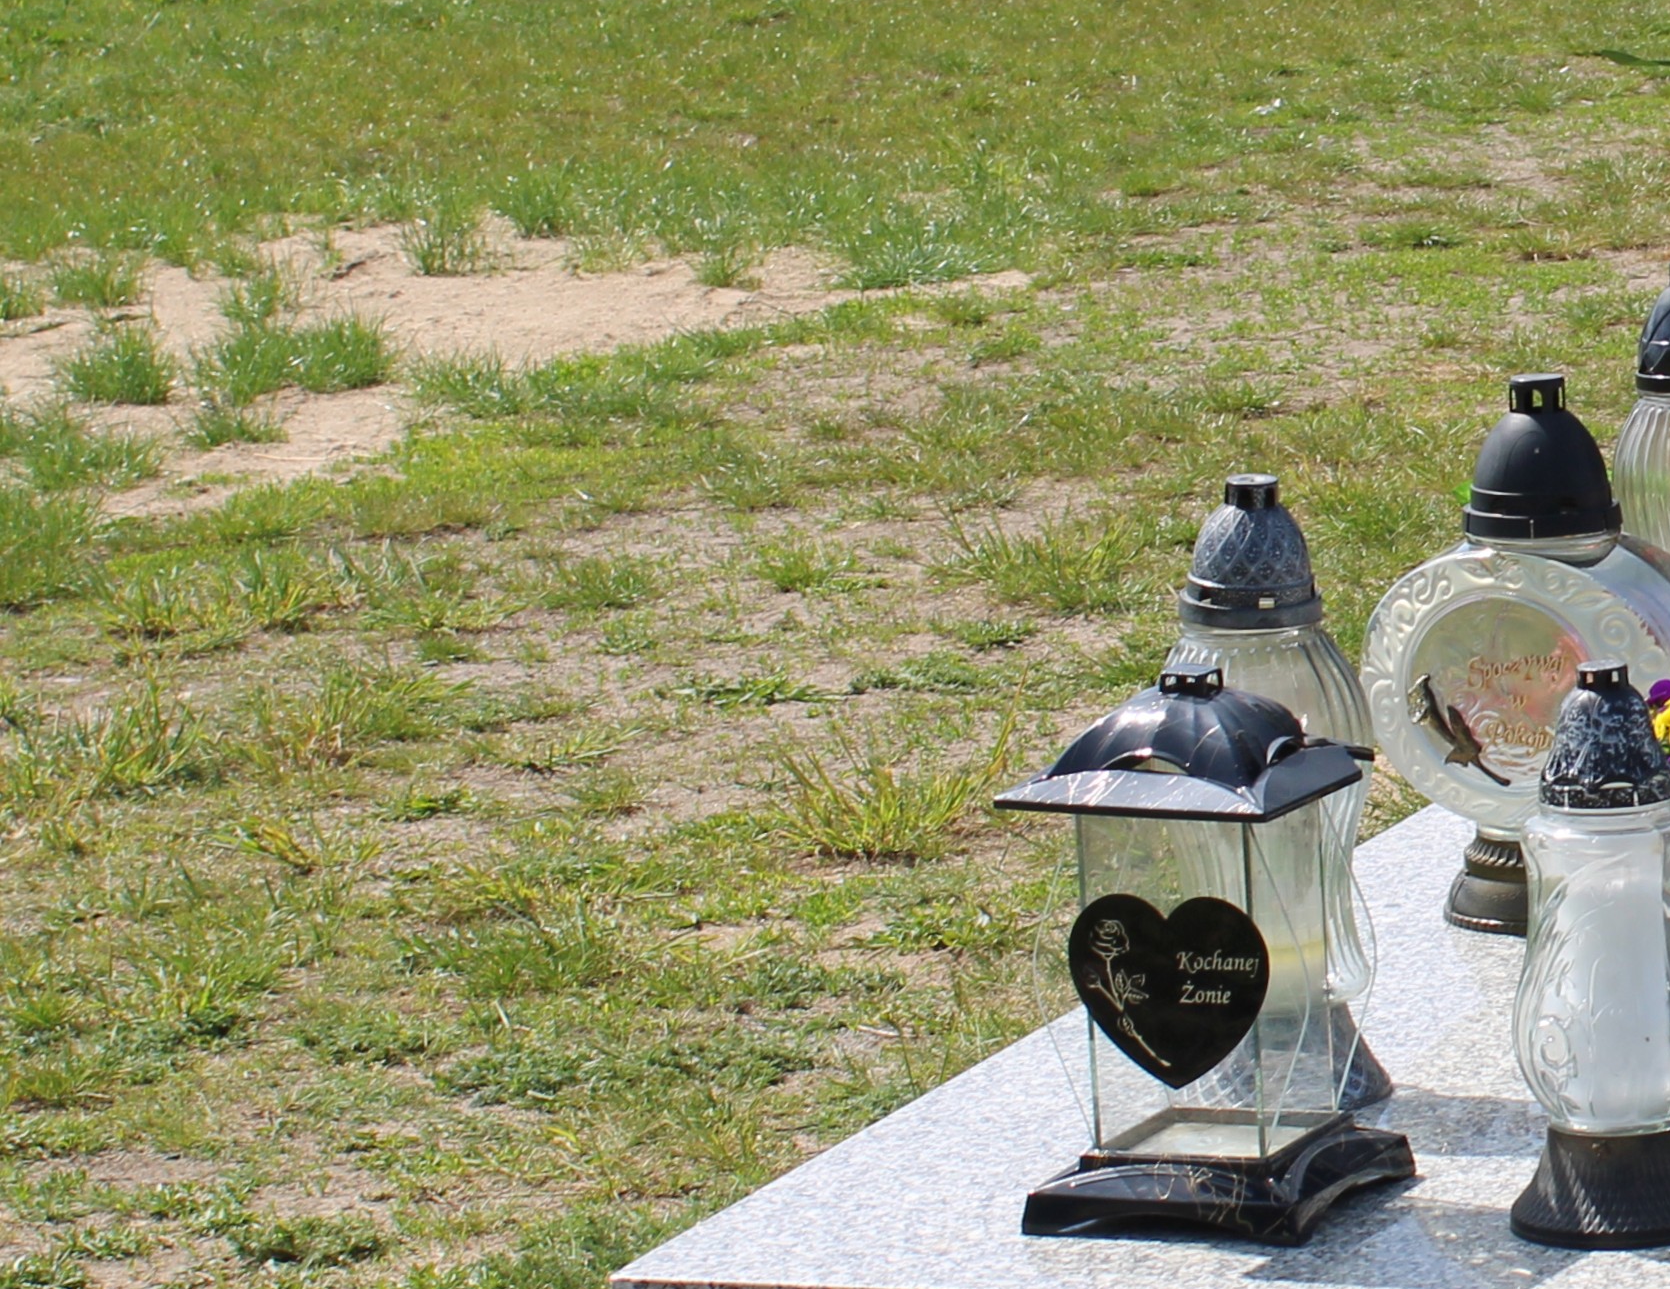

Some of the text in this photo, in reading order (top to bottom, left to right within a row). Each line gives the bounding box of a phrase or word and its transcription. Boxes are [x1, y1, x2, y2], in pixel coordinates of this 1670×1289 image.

[1511, 694, 1528, 708] w
[1176, 948, 1261, 978] Kochanej
[1179, 979, 1232, 1005] Żonie
